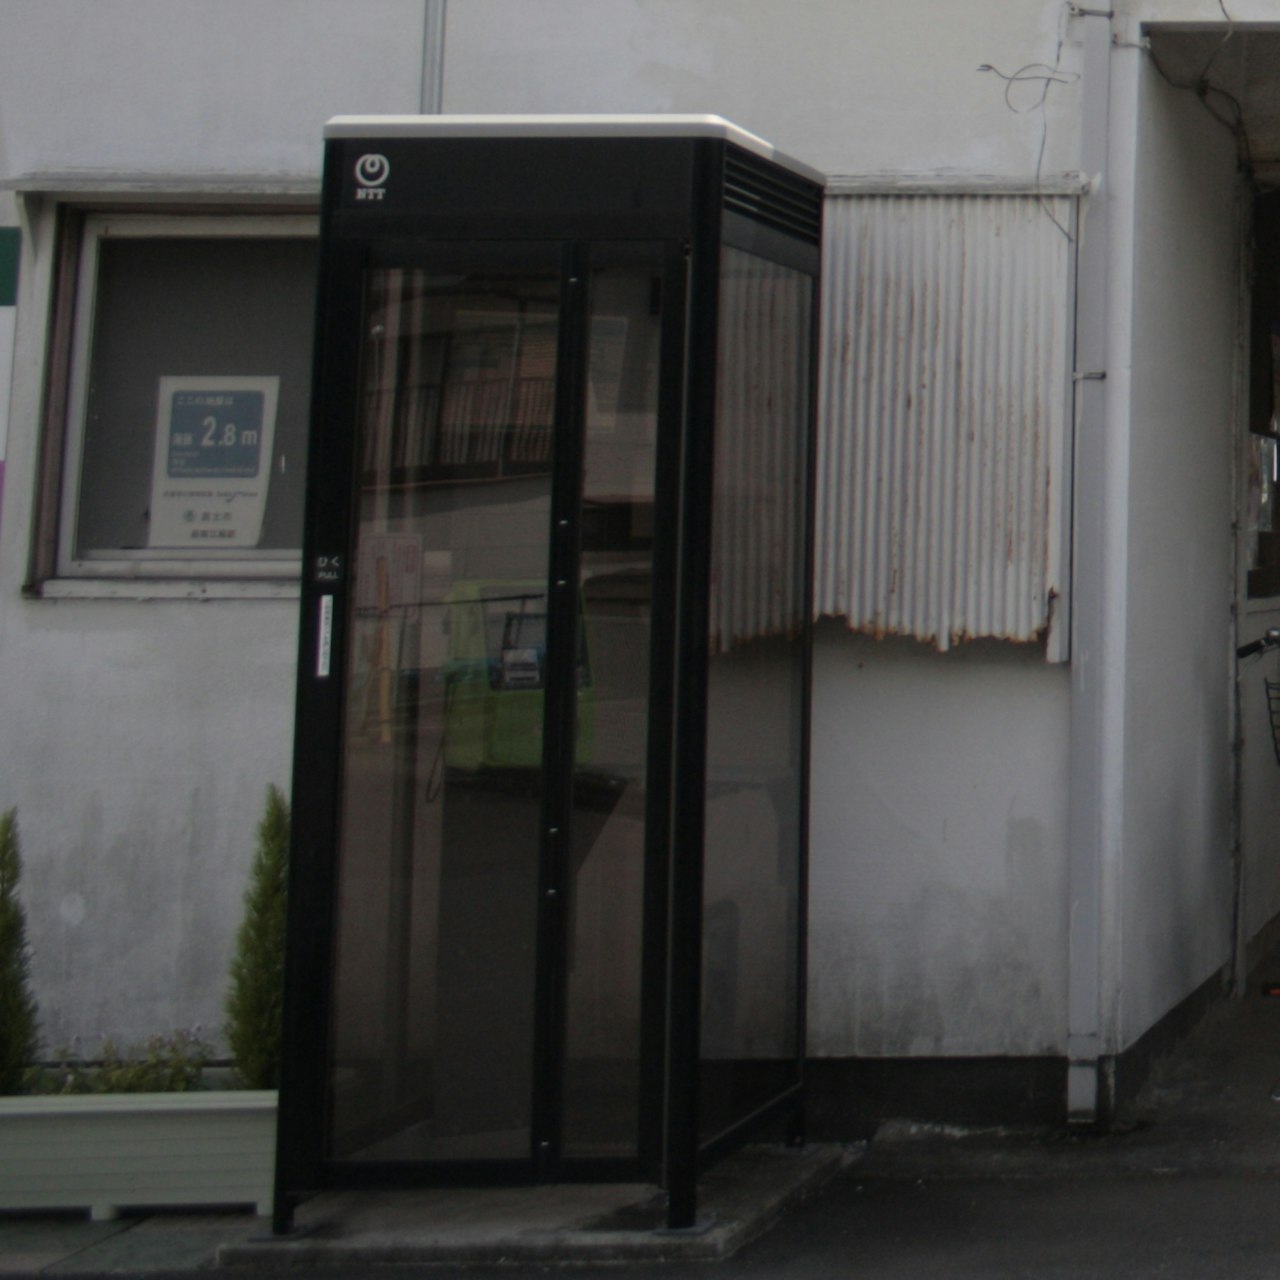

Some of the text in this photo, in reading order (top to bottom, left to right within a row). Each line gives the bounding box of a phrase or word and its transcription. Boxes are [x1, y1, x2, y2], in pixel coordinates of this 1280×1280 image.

[355, 188, 386, 200] NTT
[201, 415, 237, 447] 2.8
[241, 430, 257, 445] m
